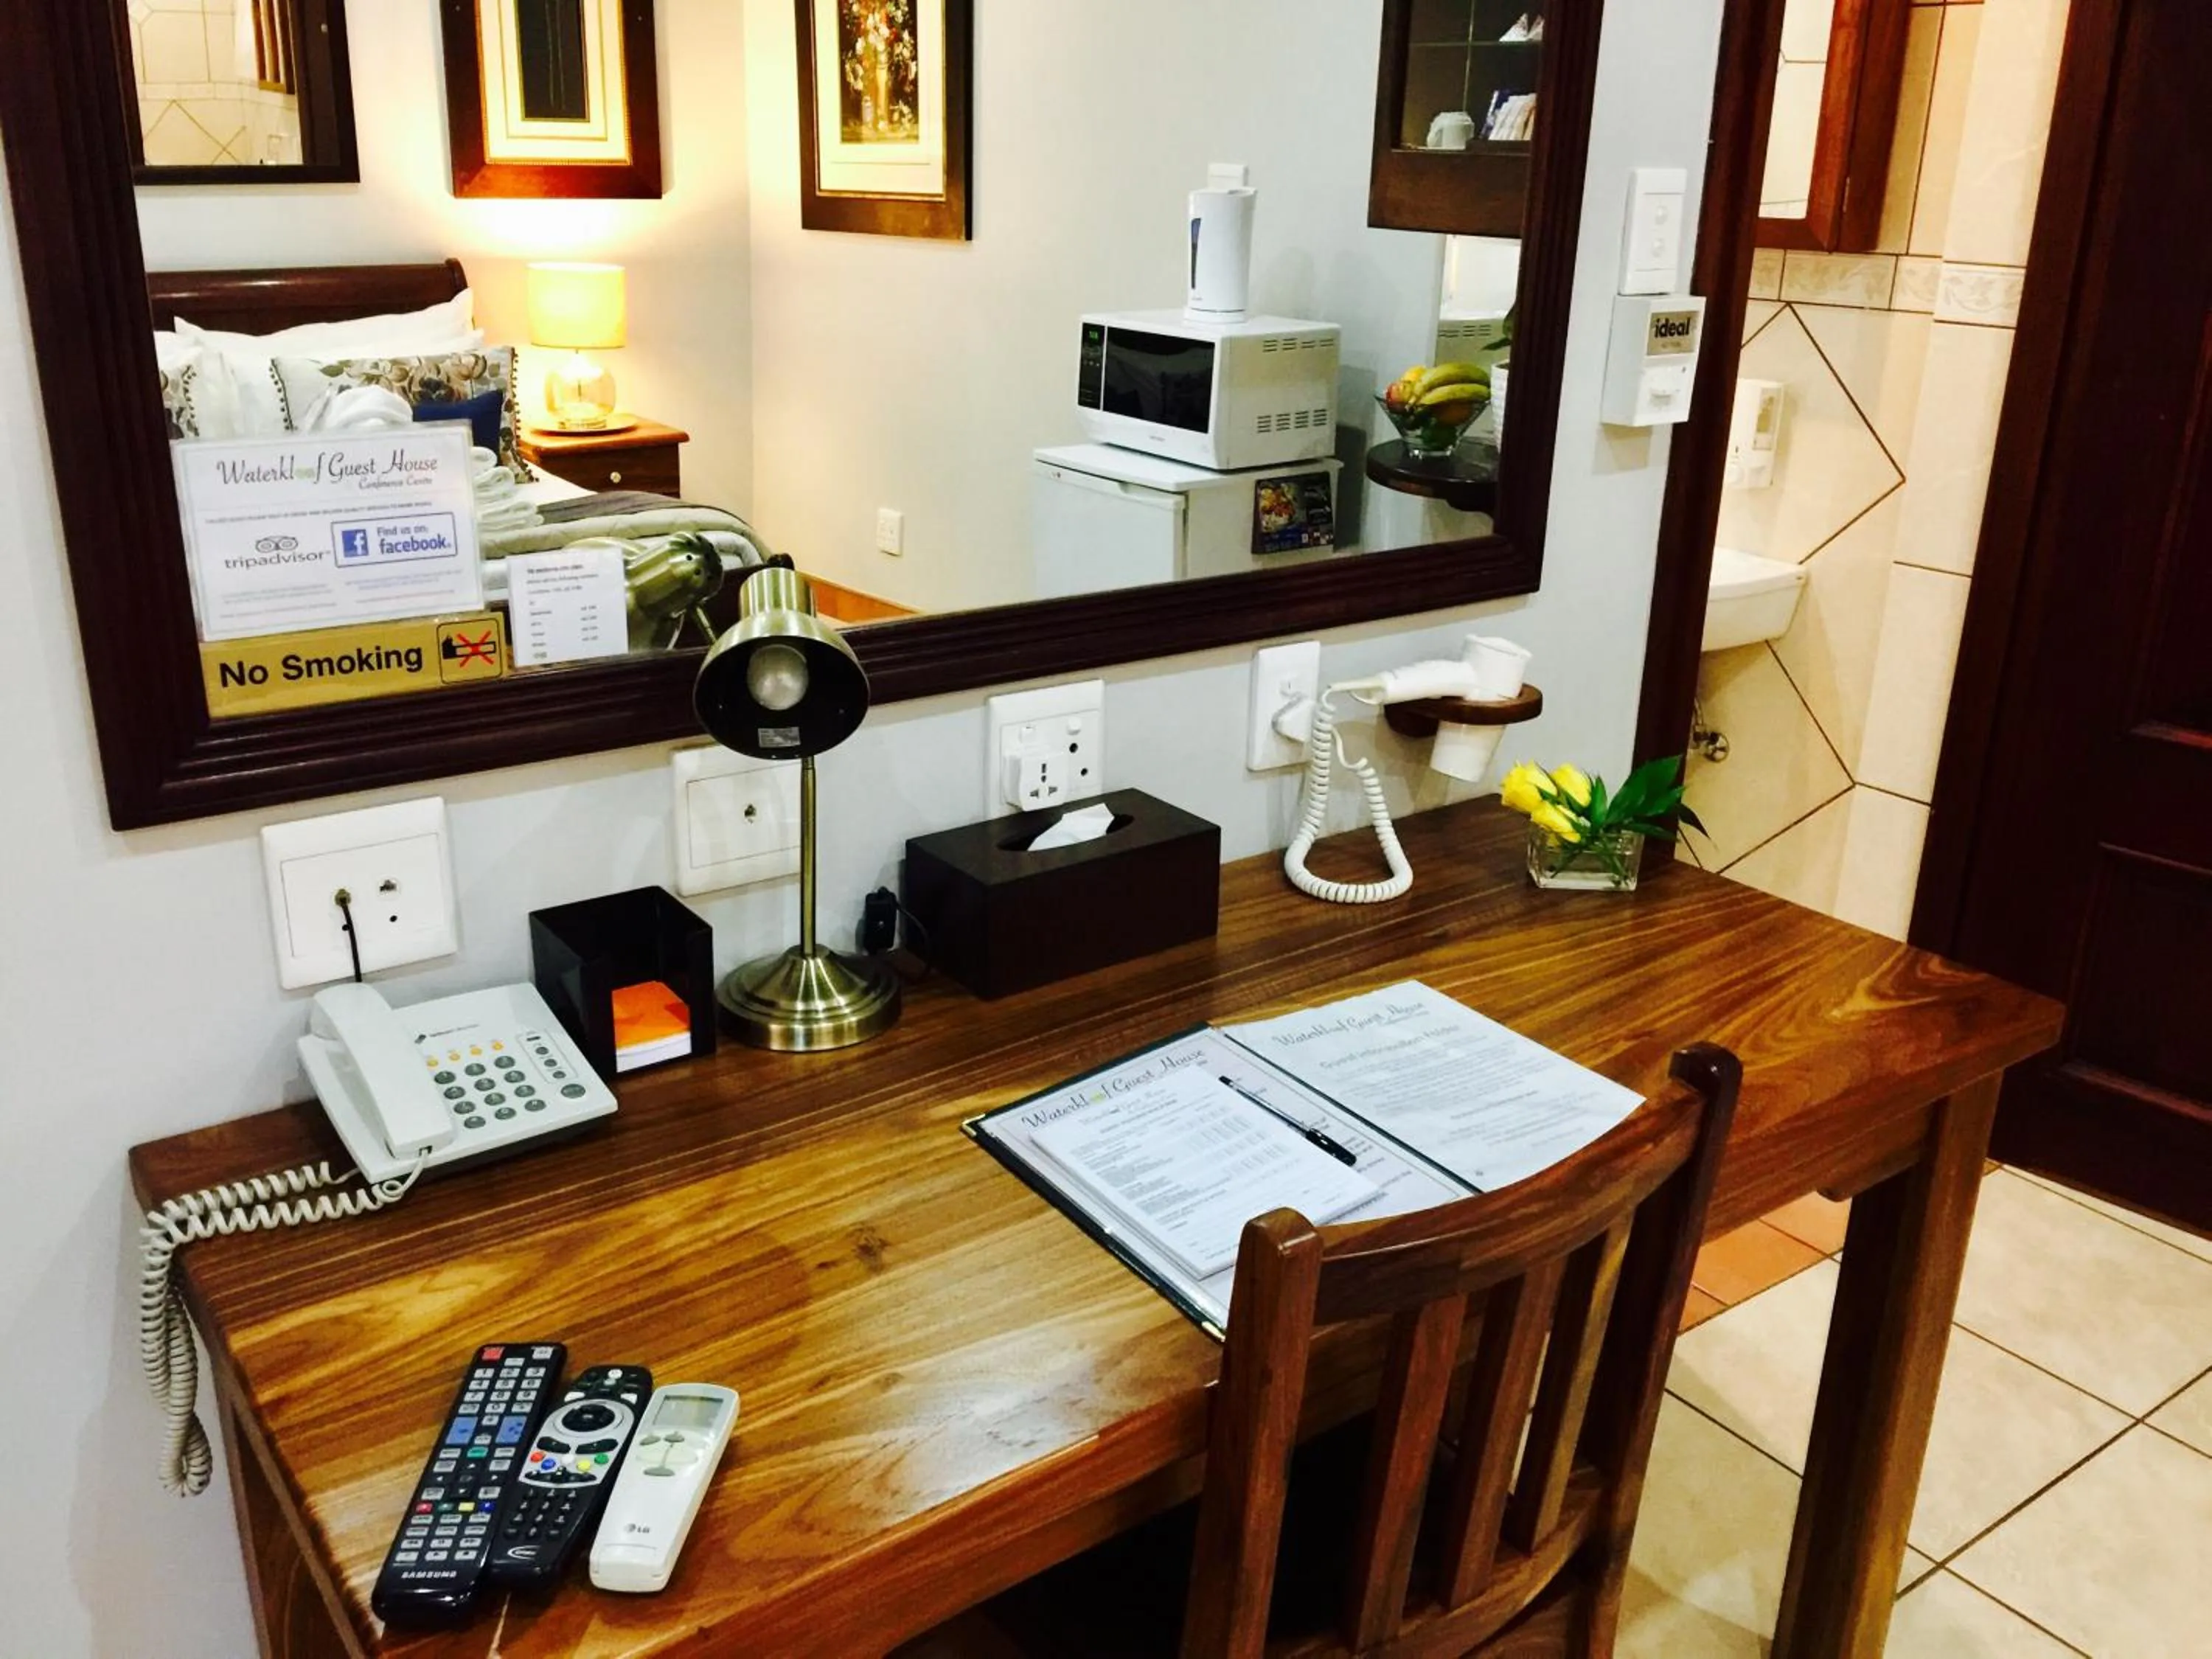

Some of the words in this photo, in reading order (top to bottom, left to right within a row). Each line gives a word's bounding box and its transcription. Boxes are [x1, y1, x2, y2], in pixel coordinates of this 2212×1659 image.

[1655, 316, 1691, 338] ideal
[217, 452, 325, 484] Waterklf
[328, 451, 376, 484] Guest
[381, 448, 438, 476] House
[377, 525, 397, 537] Find
[400, 526, 411, 535] us
[224, 553, 323, 570] tripadvisor
[219, 661, 268, 688] No
[282, 645, 422, 681] Smoking
[1021, 1084, 1111, 1128] Waterklf
[1113, 1069, 1157, 1094] Guest
[1157, 1048, 1207, 1075] House
